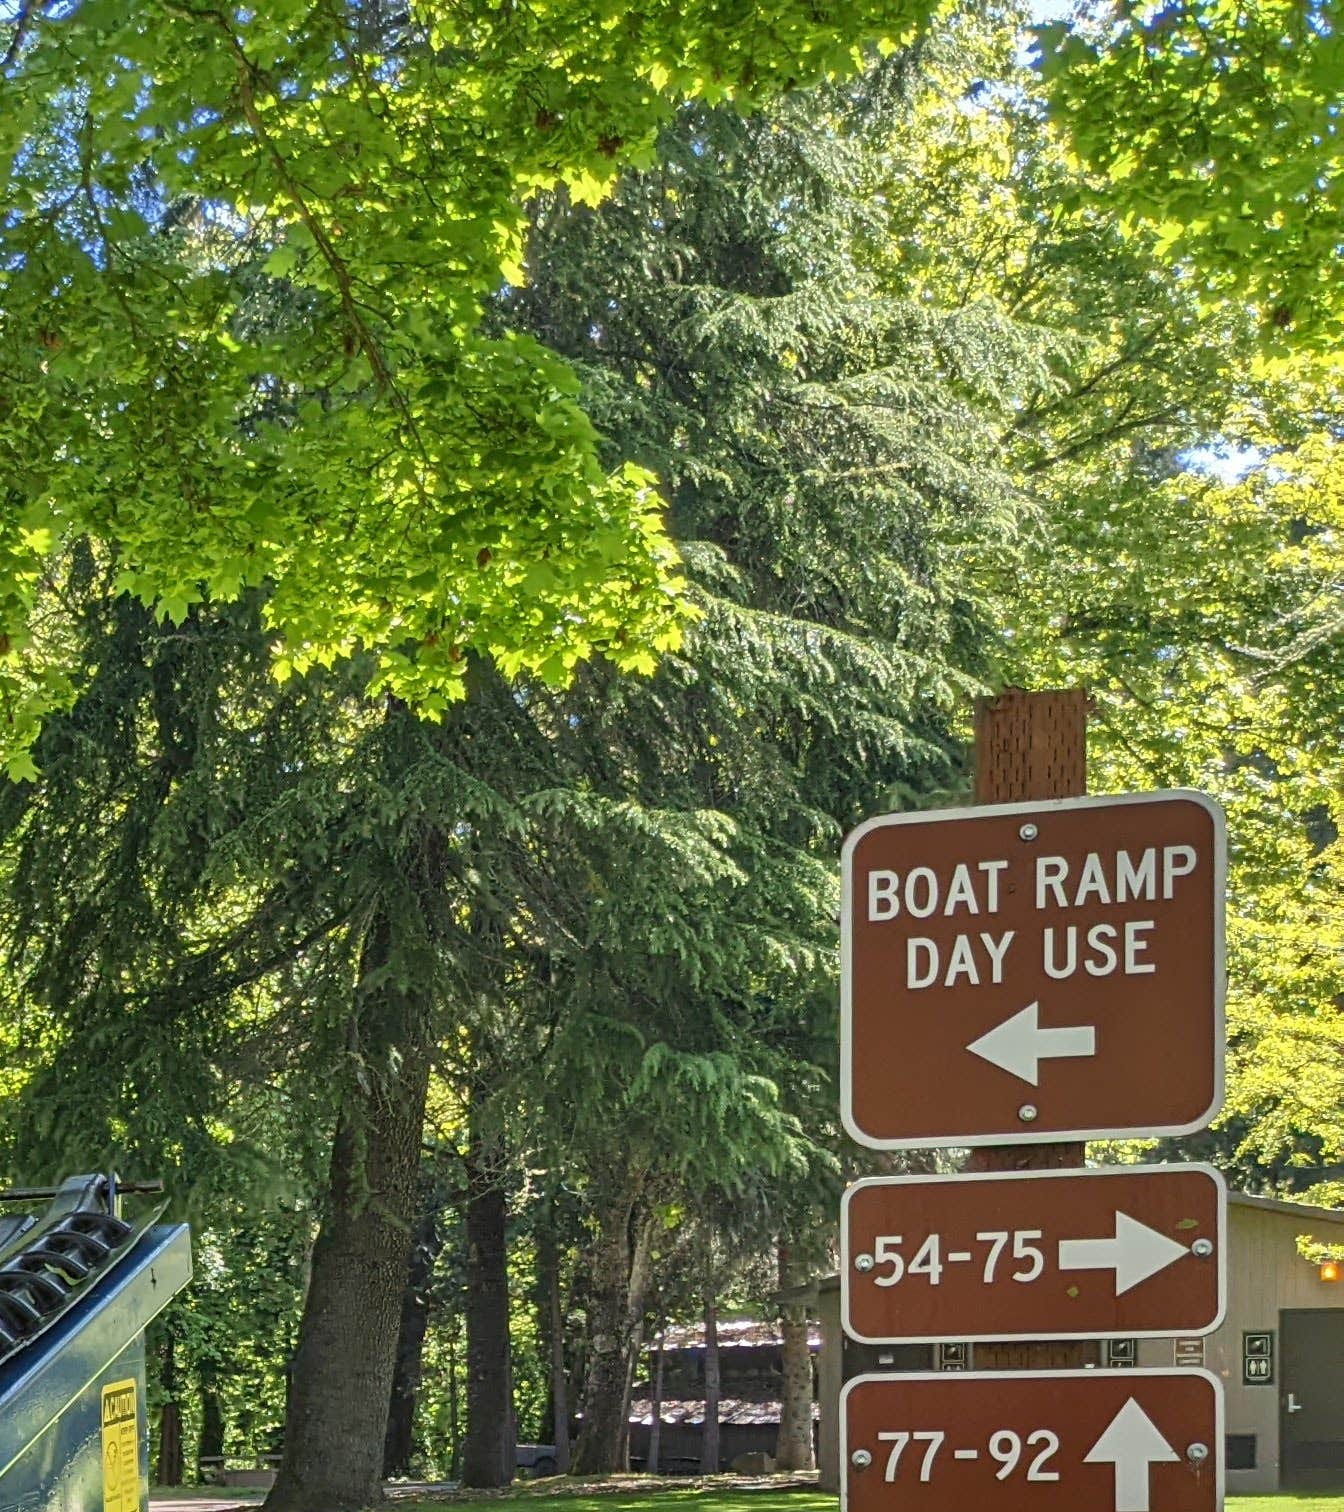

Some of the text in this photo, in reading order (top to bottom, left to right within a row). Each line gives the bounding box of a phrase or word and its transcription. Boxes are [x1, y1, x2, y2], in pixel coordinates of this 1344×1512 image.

[867, 844, 1198, 924] BOAT RAMP
[905, 919, 1156, 990] DAY USE
[872, 1228, 1044, 1288] 54-75
[877, 1429, 1060, 1484] 77-92
